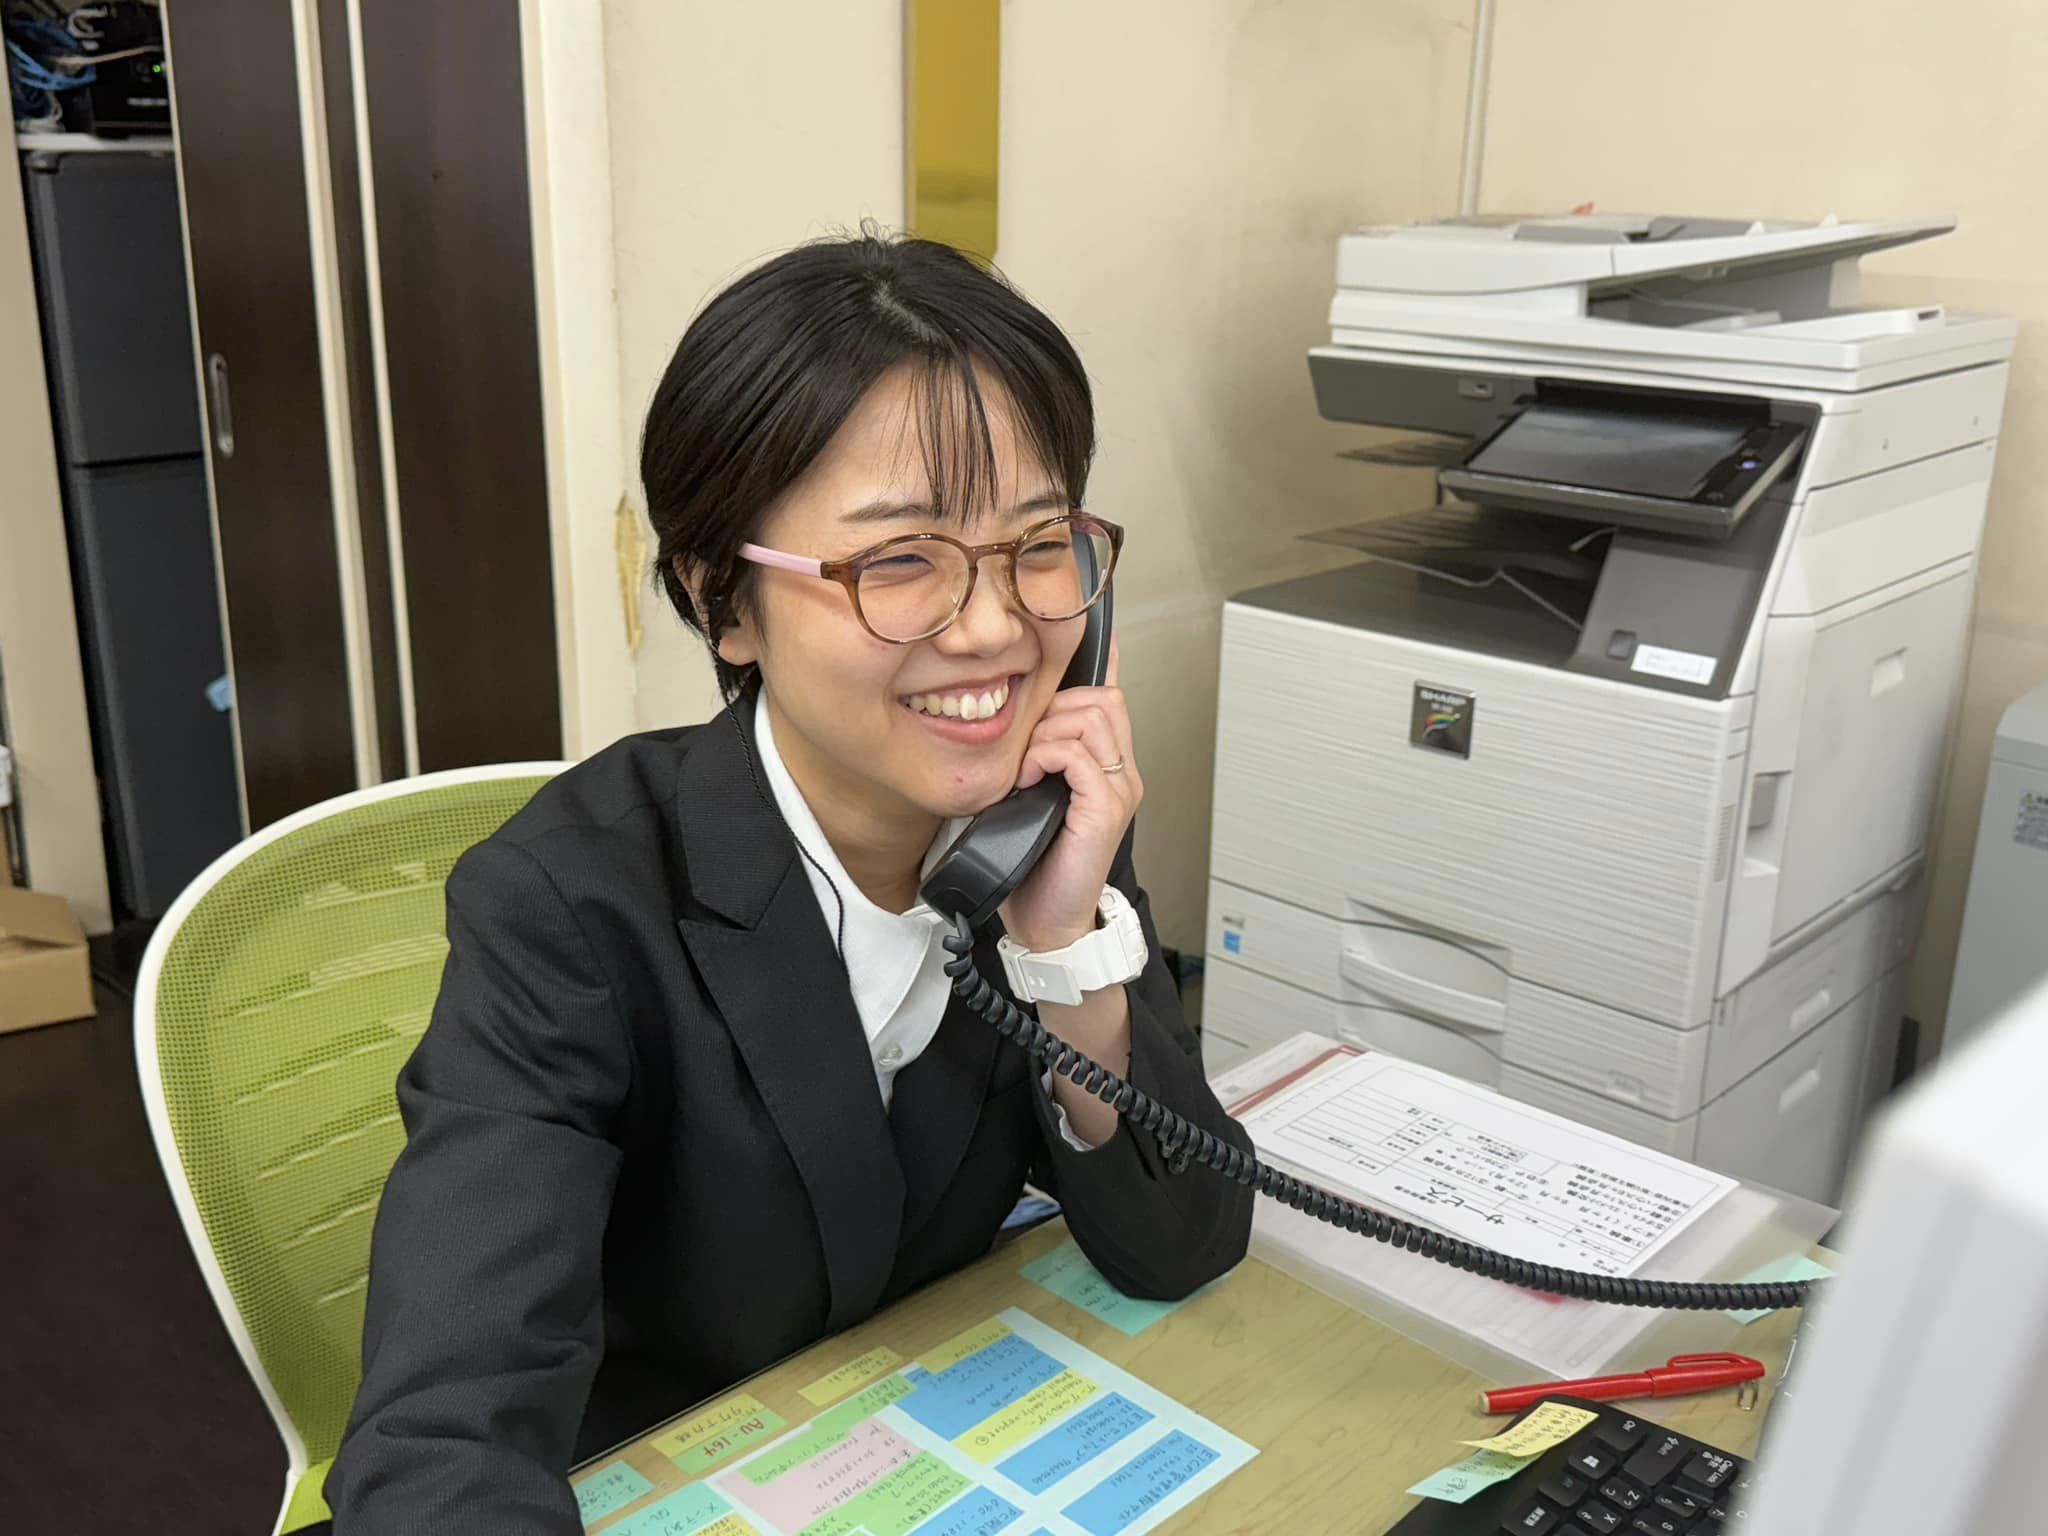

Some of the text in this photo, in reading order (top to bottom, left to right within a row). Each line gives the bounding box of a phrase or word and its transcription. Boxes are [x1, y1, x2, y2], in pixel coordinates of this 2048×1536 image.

[1425, 1184, 1506, 1227] サービス
[1627, 1489, 1639, 1501] Z
[1683, 1498, 1695, 1509] A
[1603, 1512, 1615, 1524] X
[1661, 1520, 1673, 1532] S
